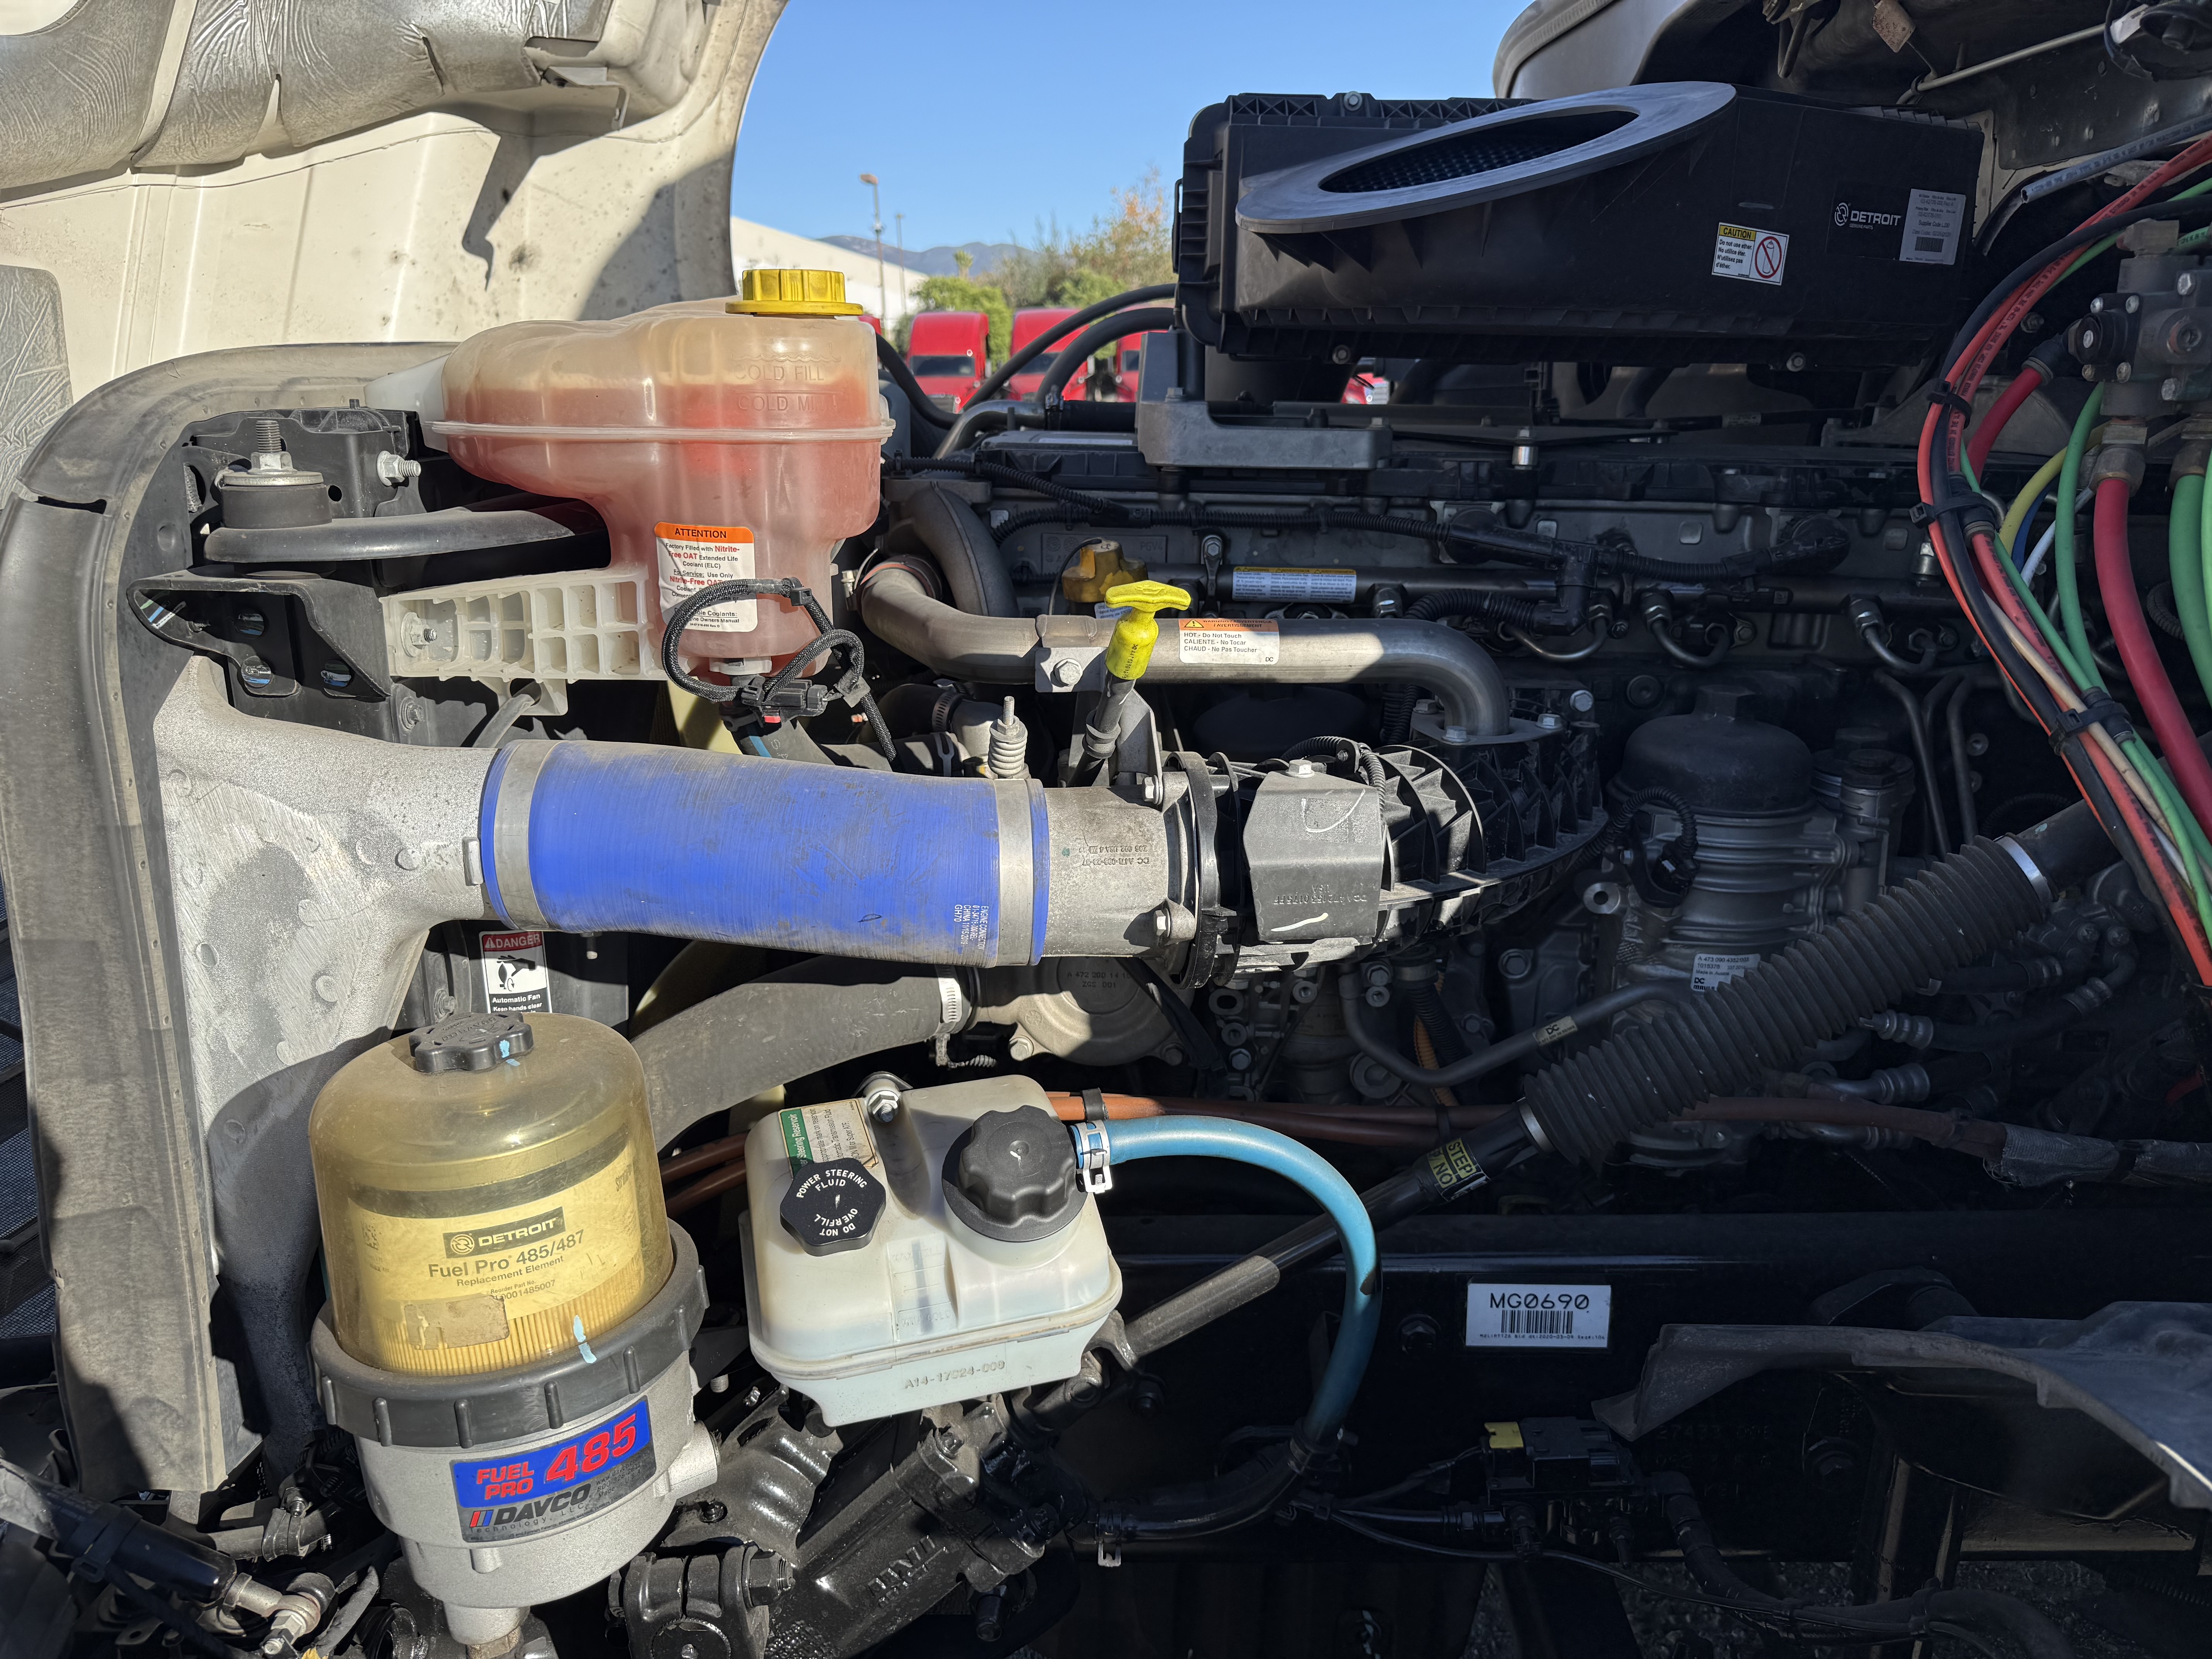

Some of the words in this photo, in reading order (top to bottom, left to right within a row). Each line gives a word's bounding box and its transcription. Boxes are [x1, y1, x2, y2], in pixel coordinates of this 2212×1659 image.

[1850, 210, 1902, 226] DETROIT
[1723, 228, 1751, 239] CAUTION
[734, 364, 785, 380] COLD
[795, 366, 824, 380] FILL
[738, 396, 788, 411] COLD
[675, 528, 726, 538] ATTENTION
[670, 576, 705, 585] Nitrite-Free
[1312, 884, 1330, 893] USA
[1273, 895, 1285, 905] FF
[1287, 895, 1309, 905] 0175
[1312, 895, 1326, 903] 153
[1328, 894, 1345, 903] 472
[954, 905, 962, 922] GH70
[963, 905, 971, 921] CHINA
[980, 906, 989, 924] ENGINE
[496, 933, 540, 948] DANGER
[961, 923, 970, 944] 11/15/2019
[978, 924, 987, 950] CONNECTION
[1546, 1024, 1559, 1035] DC
[788, 1114, 801, 1137] Reservoir
[831, 1118, 840, 1143] Transmission
[842, 1121, 850, 1130] ATF.
[797, 1136, 807, 1159] Steering
[1448, 1142, 1472, 1173] STEP
[1433, 1162, 1453, 1184] NO
[796, 1173, 821, 1198] POWER
[825, 1169, 868, 1188] STEERING
[815, 1179, 846, 1191] FLUID
[814, 1208, 858, 1227] OVERFILL
[478, 1218, 557, 1247] DETROIT
[843, 1223, 856, 1233] DO
[428, 1262, 468, 1277] Fuel
[476, 1259, 510, 1274] Pro
[516, 1229, 584, 1264] 485/487
[457, 1269, 523, 1287] Replacement
[526, 1255, 564, 1273] Element
[490, 1285, 513, 1295] Reorder
[514, 1281, 526, 1291] Part
[1490, 1293, 1589, 1310] MG0690
[926, 1310, 951, 1321] COLD
[905, 1360, 1005, 1389] A14-17024-000
[477, 1461, 534, 1484] FUEL
[544, 1413, 640, 1484] 485
[596, 1455, 642, 1486] www.davco.com
[485, 1478, 534, 1500] PRO
[493, 1484, 591, 1525] DAVCO
[598, 1486, 616, 1498] Made
